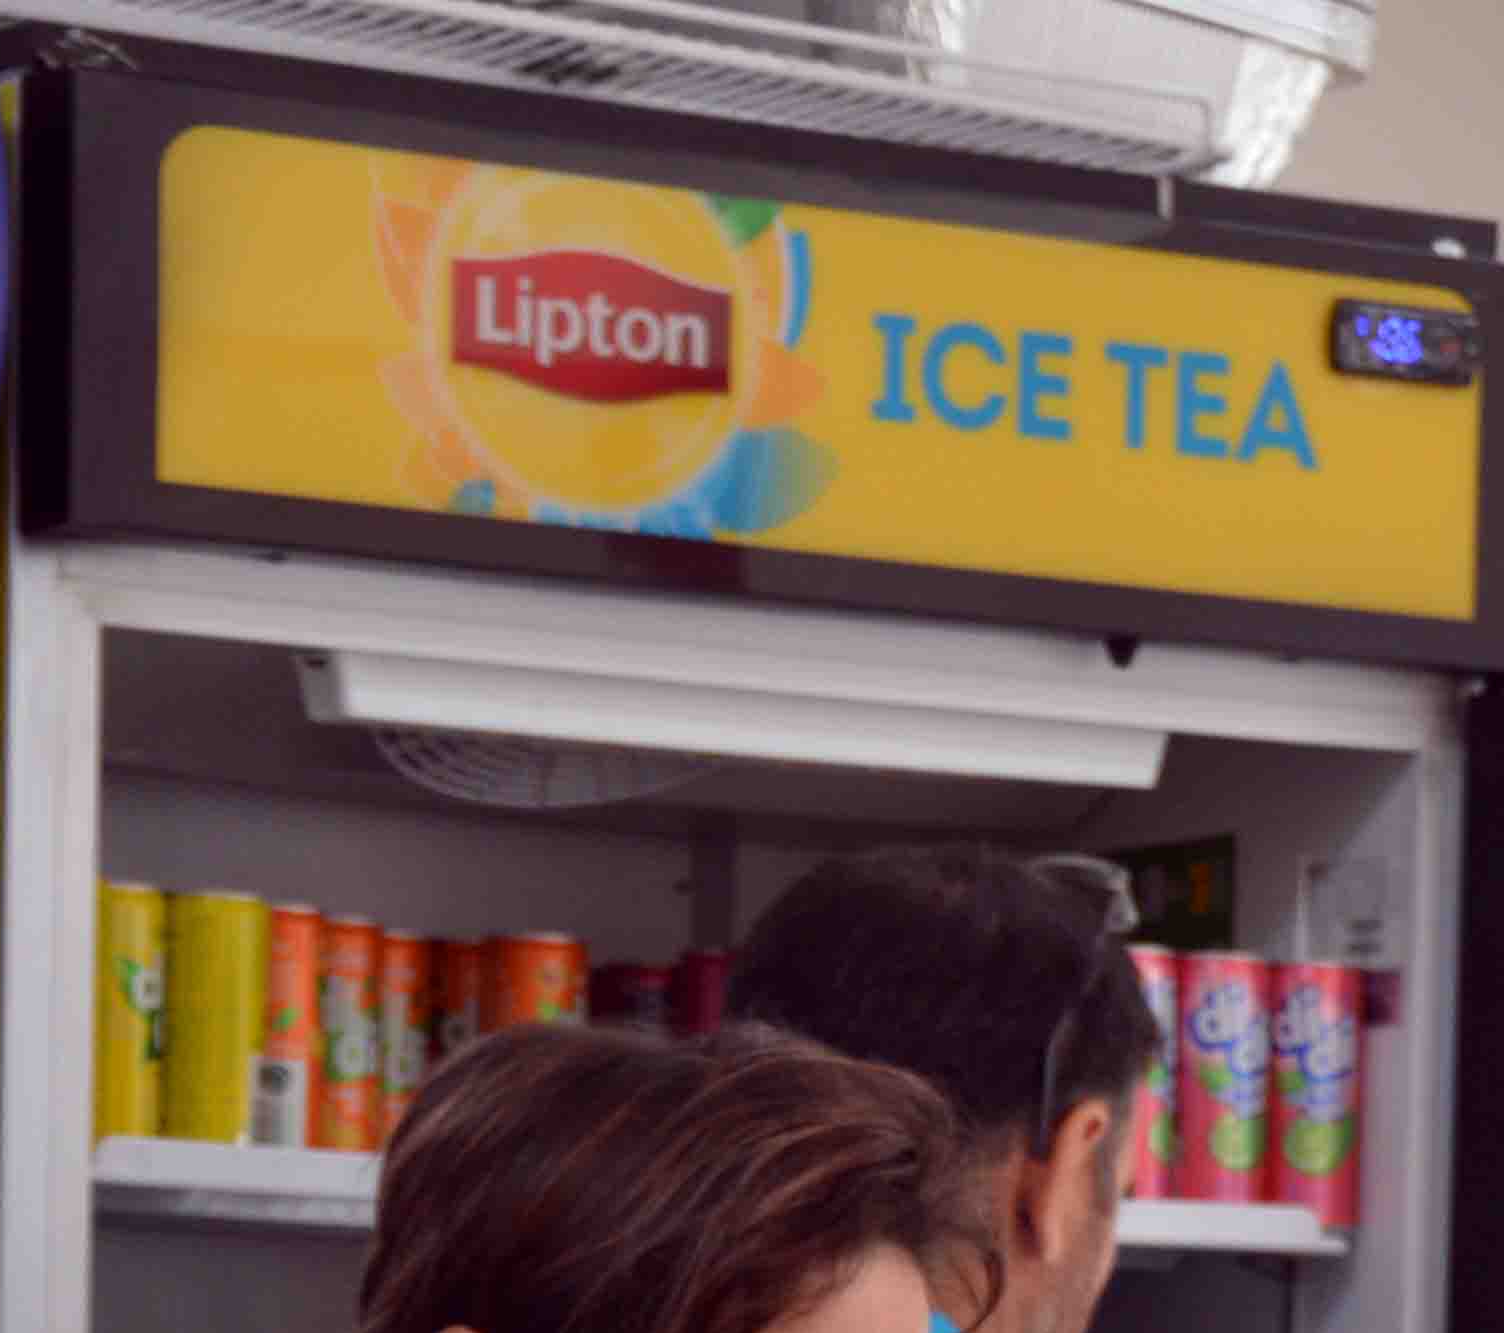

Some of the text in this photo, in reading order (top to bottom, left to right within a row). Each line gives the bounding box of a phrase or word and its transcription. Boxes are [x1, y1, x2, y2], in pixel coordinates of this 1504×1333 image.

[472, 276, 712, 373] Lipton
[868, 312, 1074, 440] ICE
[1106, 338, 1320, 472] TEA
